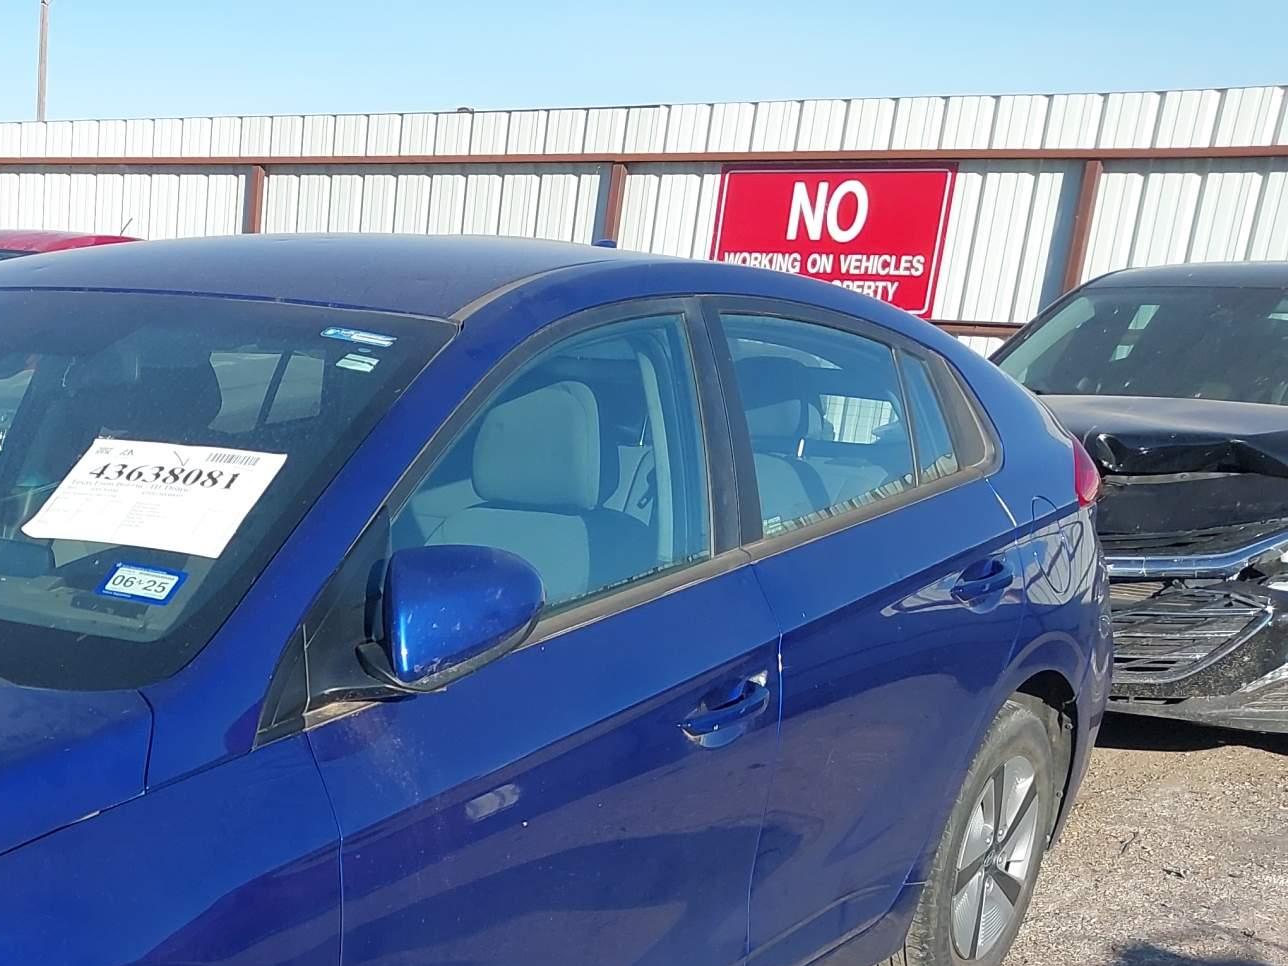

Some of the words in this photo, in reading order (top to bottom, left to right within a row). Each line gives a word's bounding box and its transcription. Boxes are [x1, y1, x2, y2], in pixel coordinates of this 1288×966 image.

[785, 179, 869, 243] NO
[724, 252, 801, 273] WORKING
[807, 254, 833, 274] ON
[840, 254, 925, 276] VEHICLES
[89, 463, 240, 490] 43638081
[112, 574, 137, 588] 06
[142, 579, 169, 594] 25
